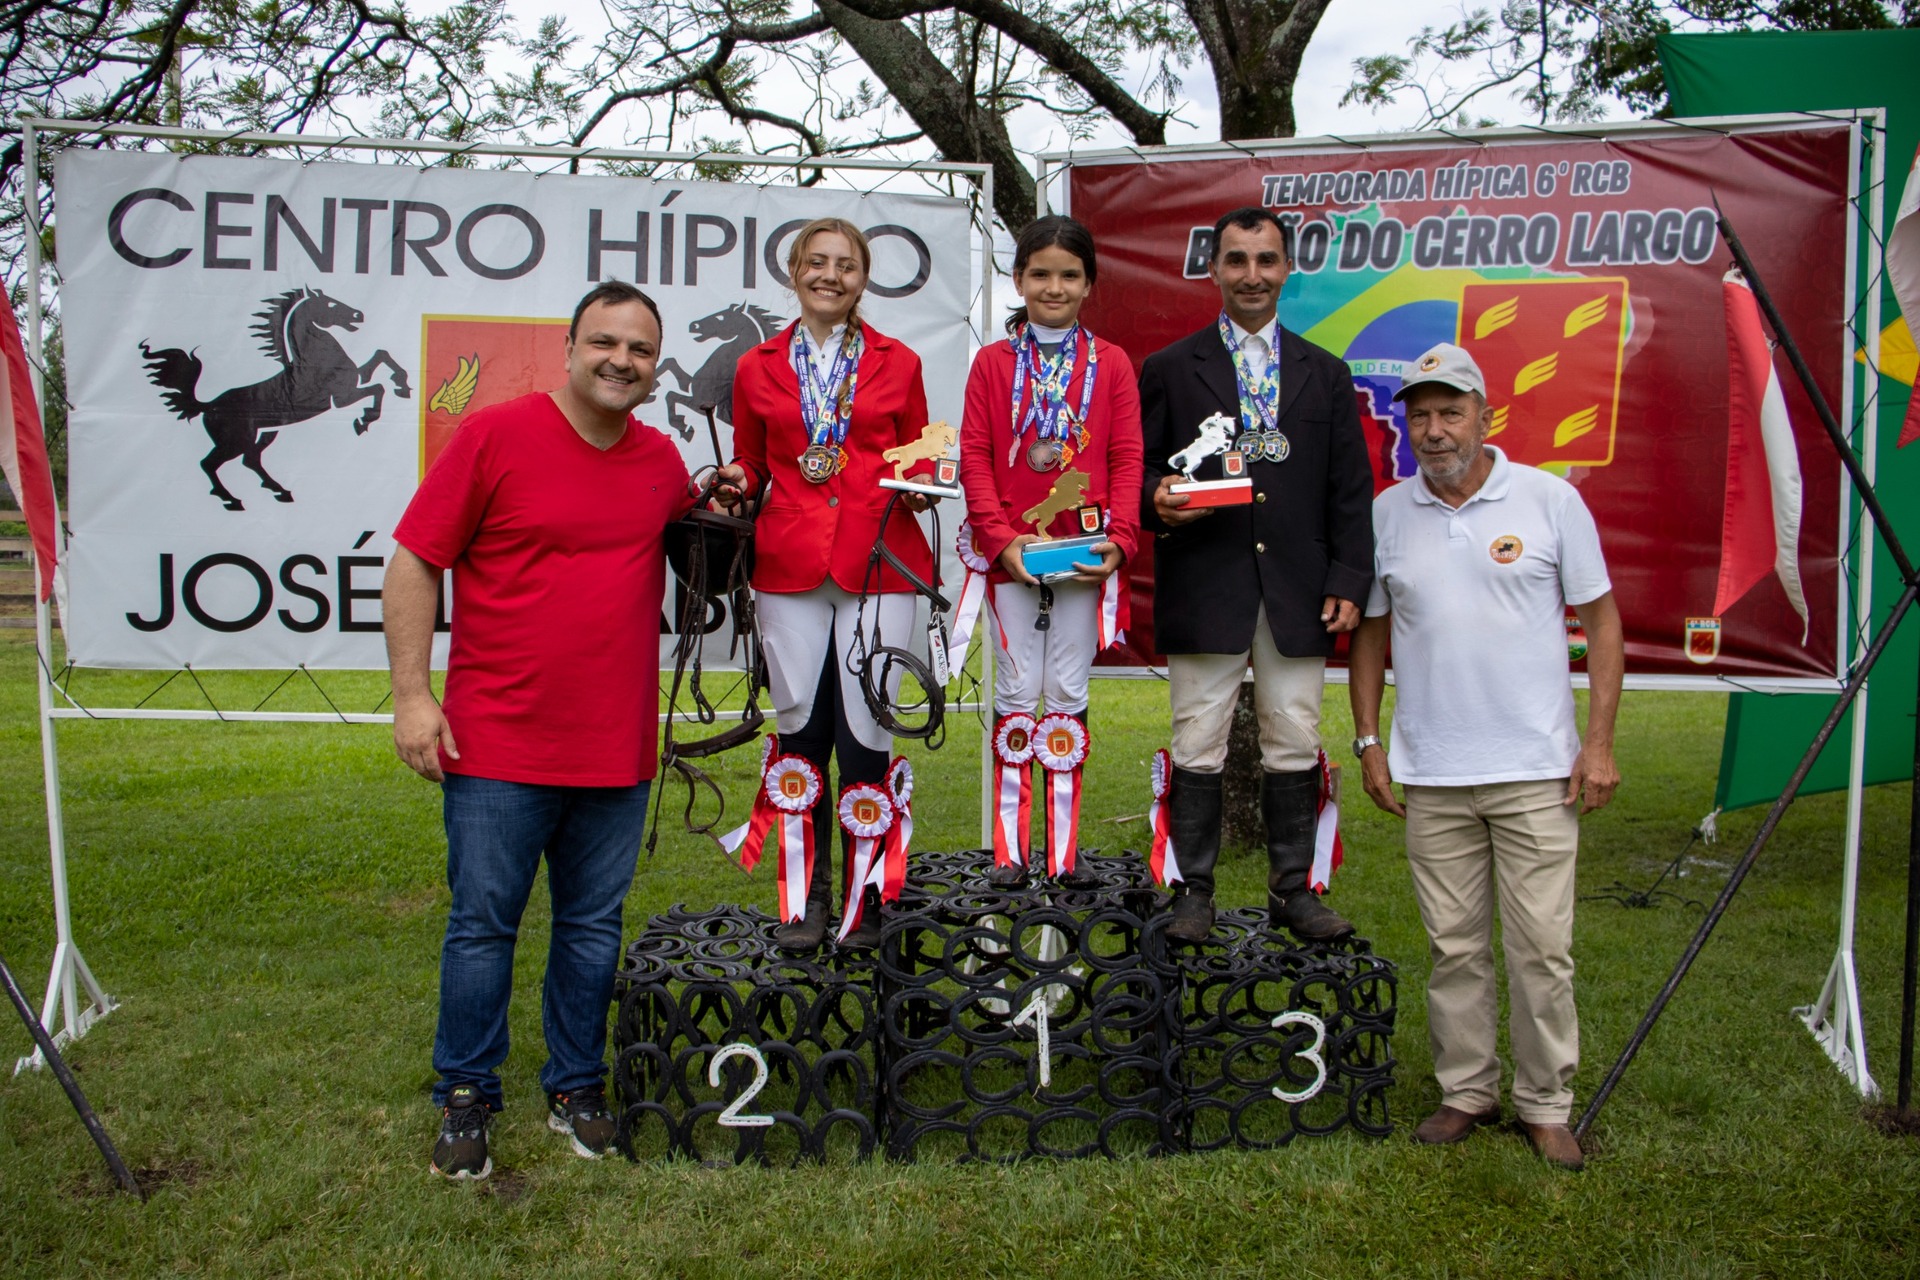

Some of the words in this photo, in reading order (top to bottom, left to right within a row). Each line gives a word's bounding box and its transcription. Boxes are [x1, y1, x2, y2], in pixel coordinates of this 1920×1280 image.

[1262, 168, 1425, 207] TEMPORADA
[1431, 160, 1528, 200] HÍPICA
[1570, 160, 1631, 196] RCB
[107, 187, 546, 280] CENTRO
[1337, 218, 1405, 272] DO
[1411, 212, 1560, 270] CERRO
[1564, 207, 1718, 266] LARGO
[1354, 362, 1403, 374] RDEM
[125, 530, 384, 633] JOSÉ
[709, 1043, 775, 1126] 2
[1012, 999, 1051, 1087] 1
[1271, 1011, 1326, 1102] 3
[454, 1088, 470, 1096] FILA
